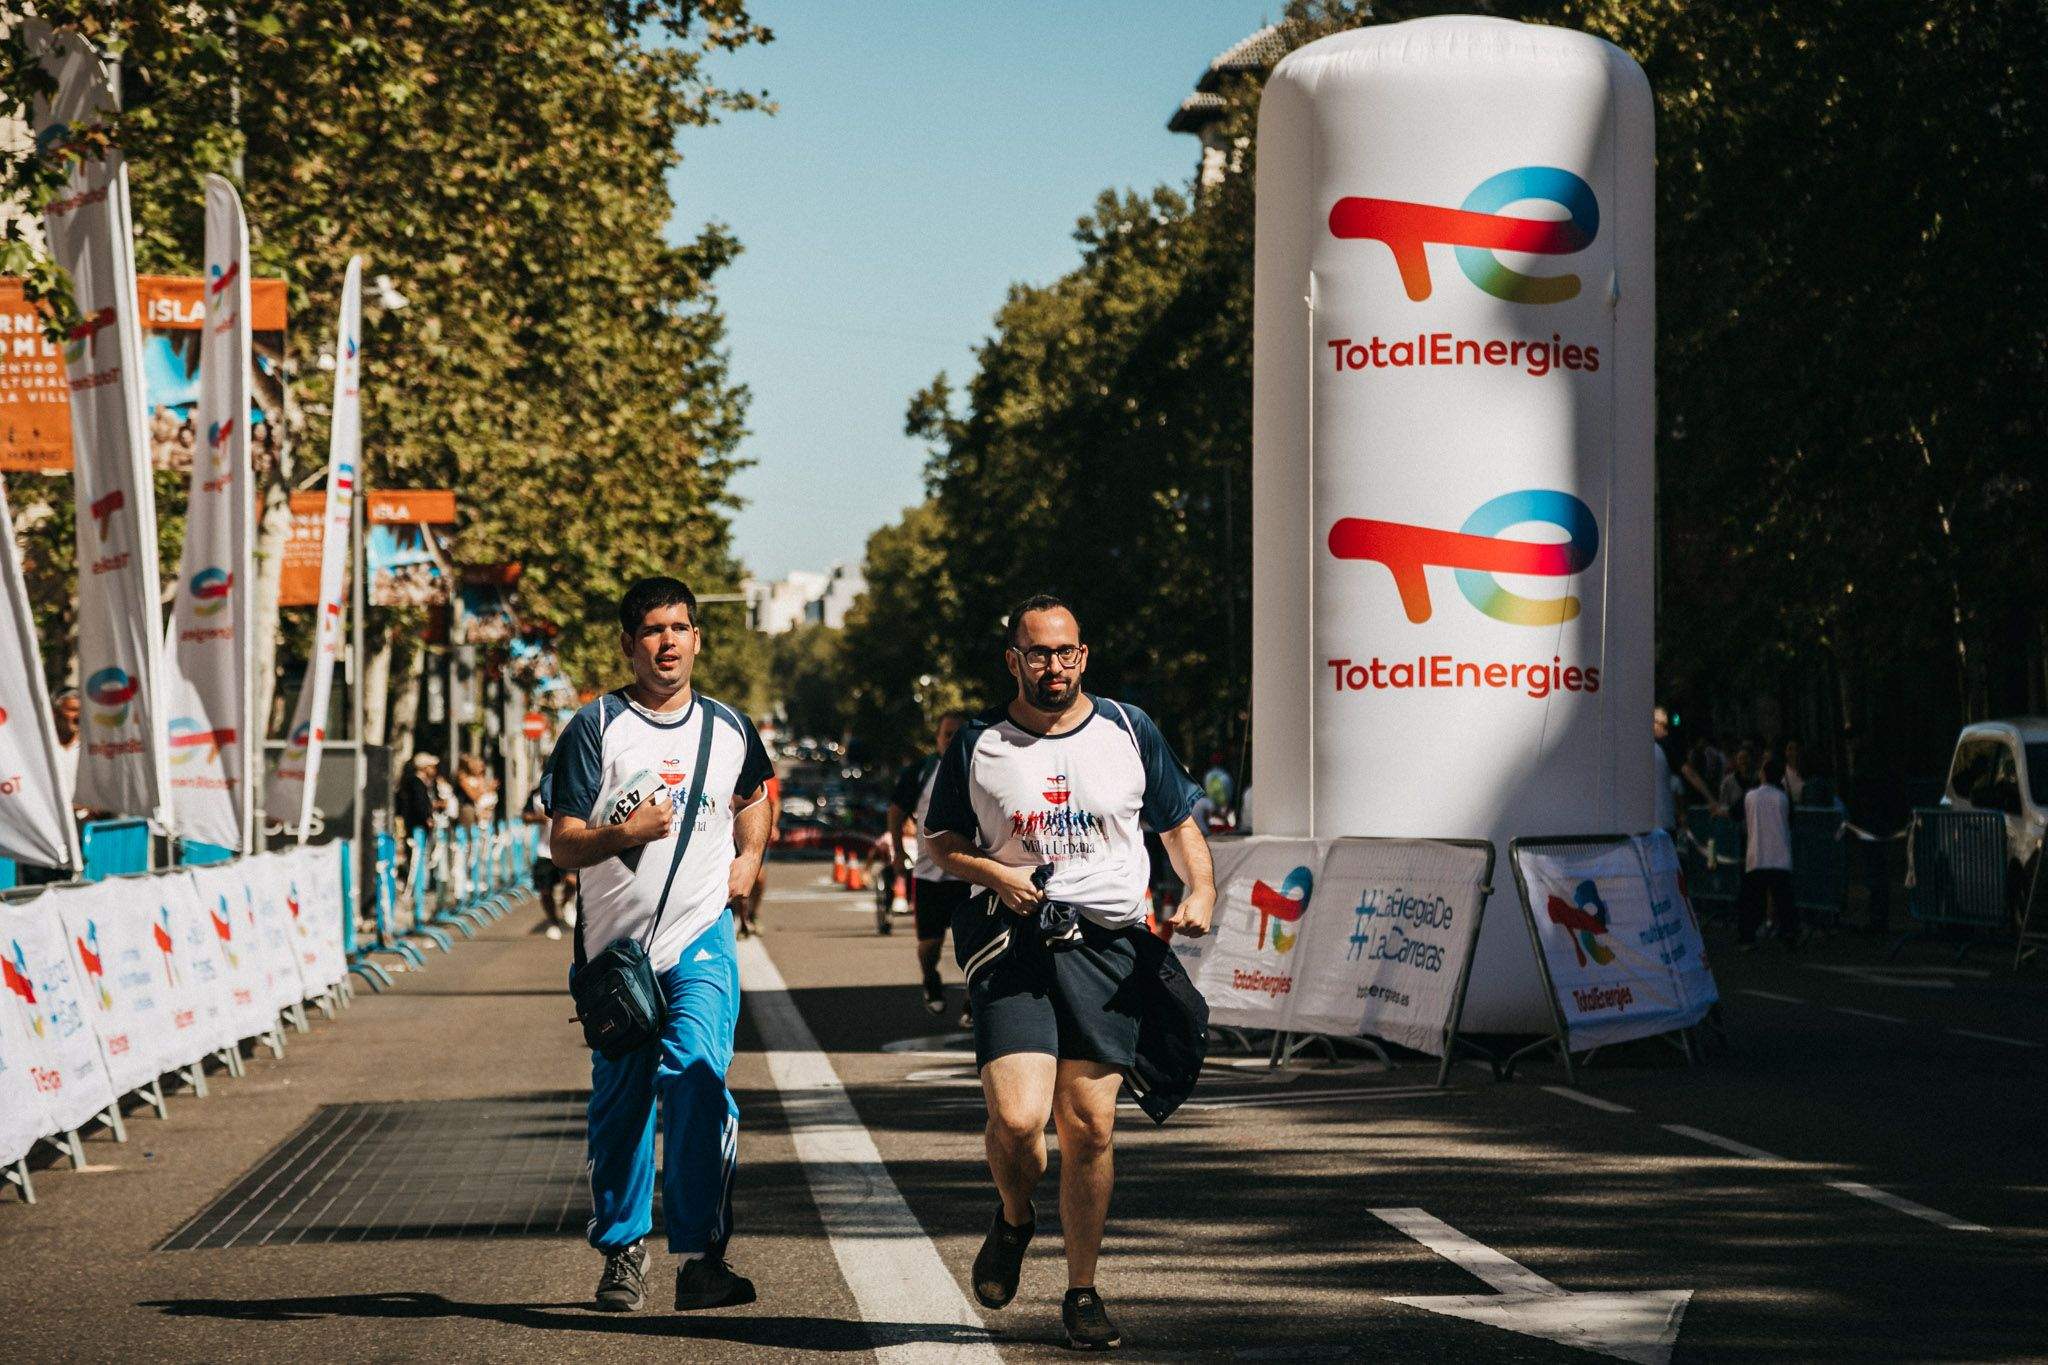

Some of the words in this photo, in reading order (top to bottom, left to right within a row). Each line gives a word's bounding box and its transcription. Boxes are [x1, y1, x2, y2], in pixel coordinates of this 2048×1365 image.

[147, 298, 206, 323] ISLA
[1328, 333, 1600, 377] TotalEnergies
[1328, 655, 1600, 699] TotalEnergies
